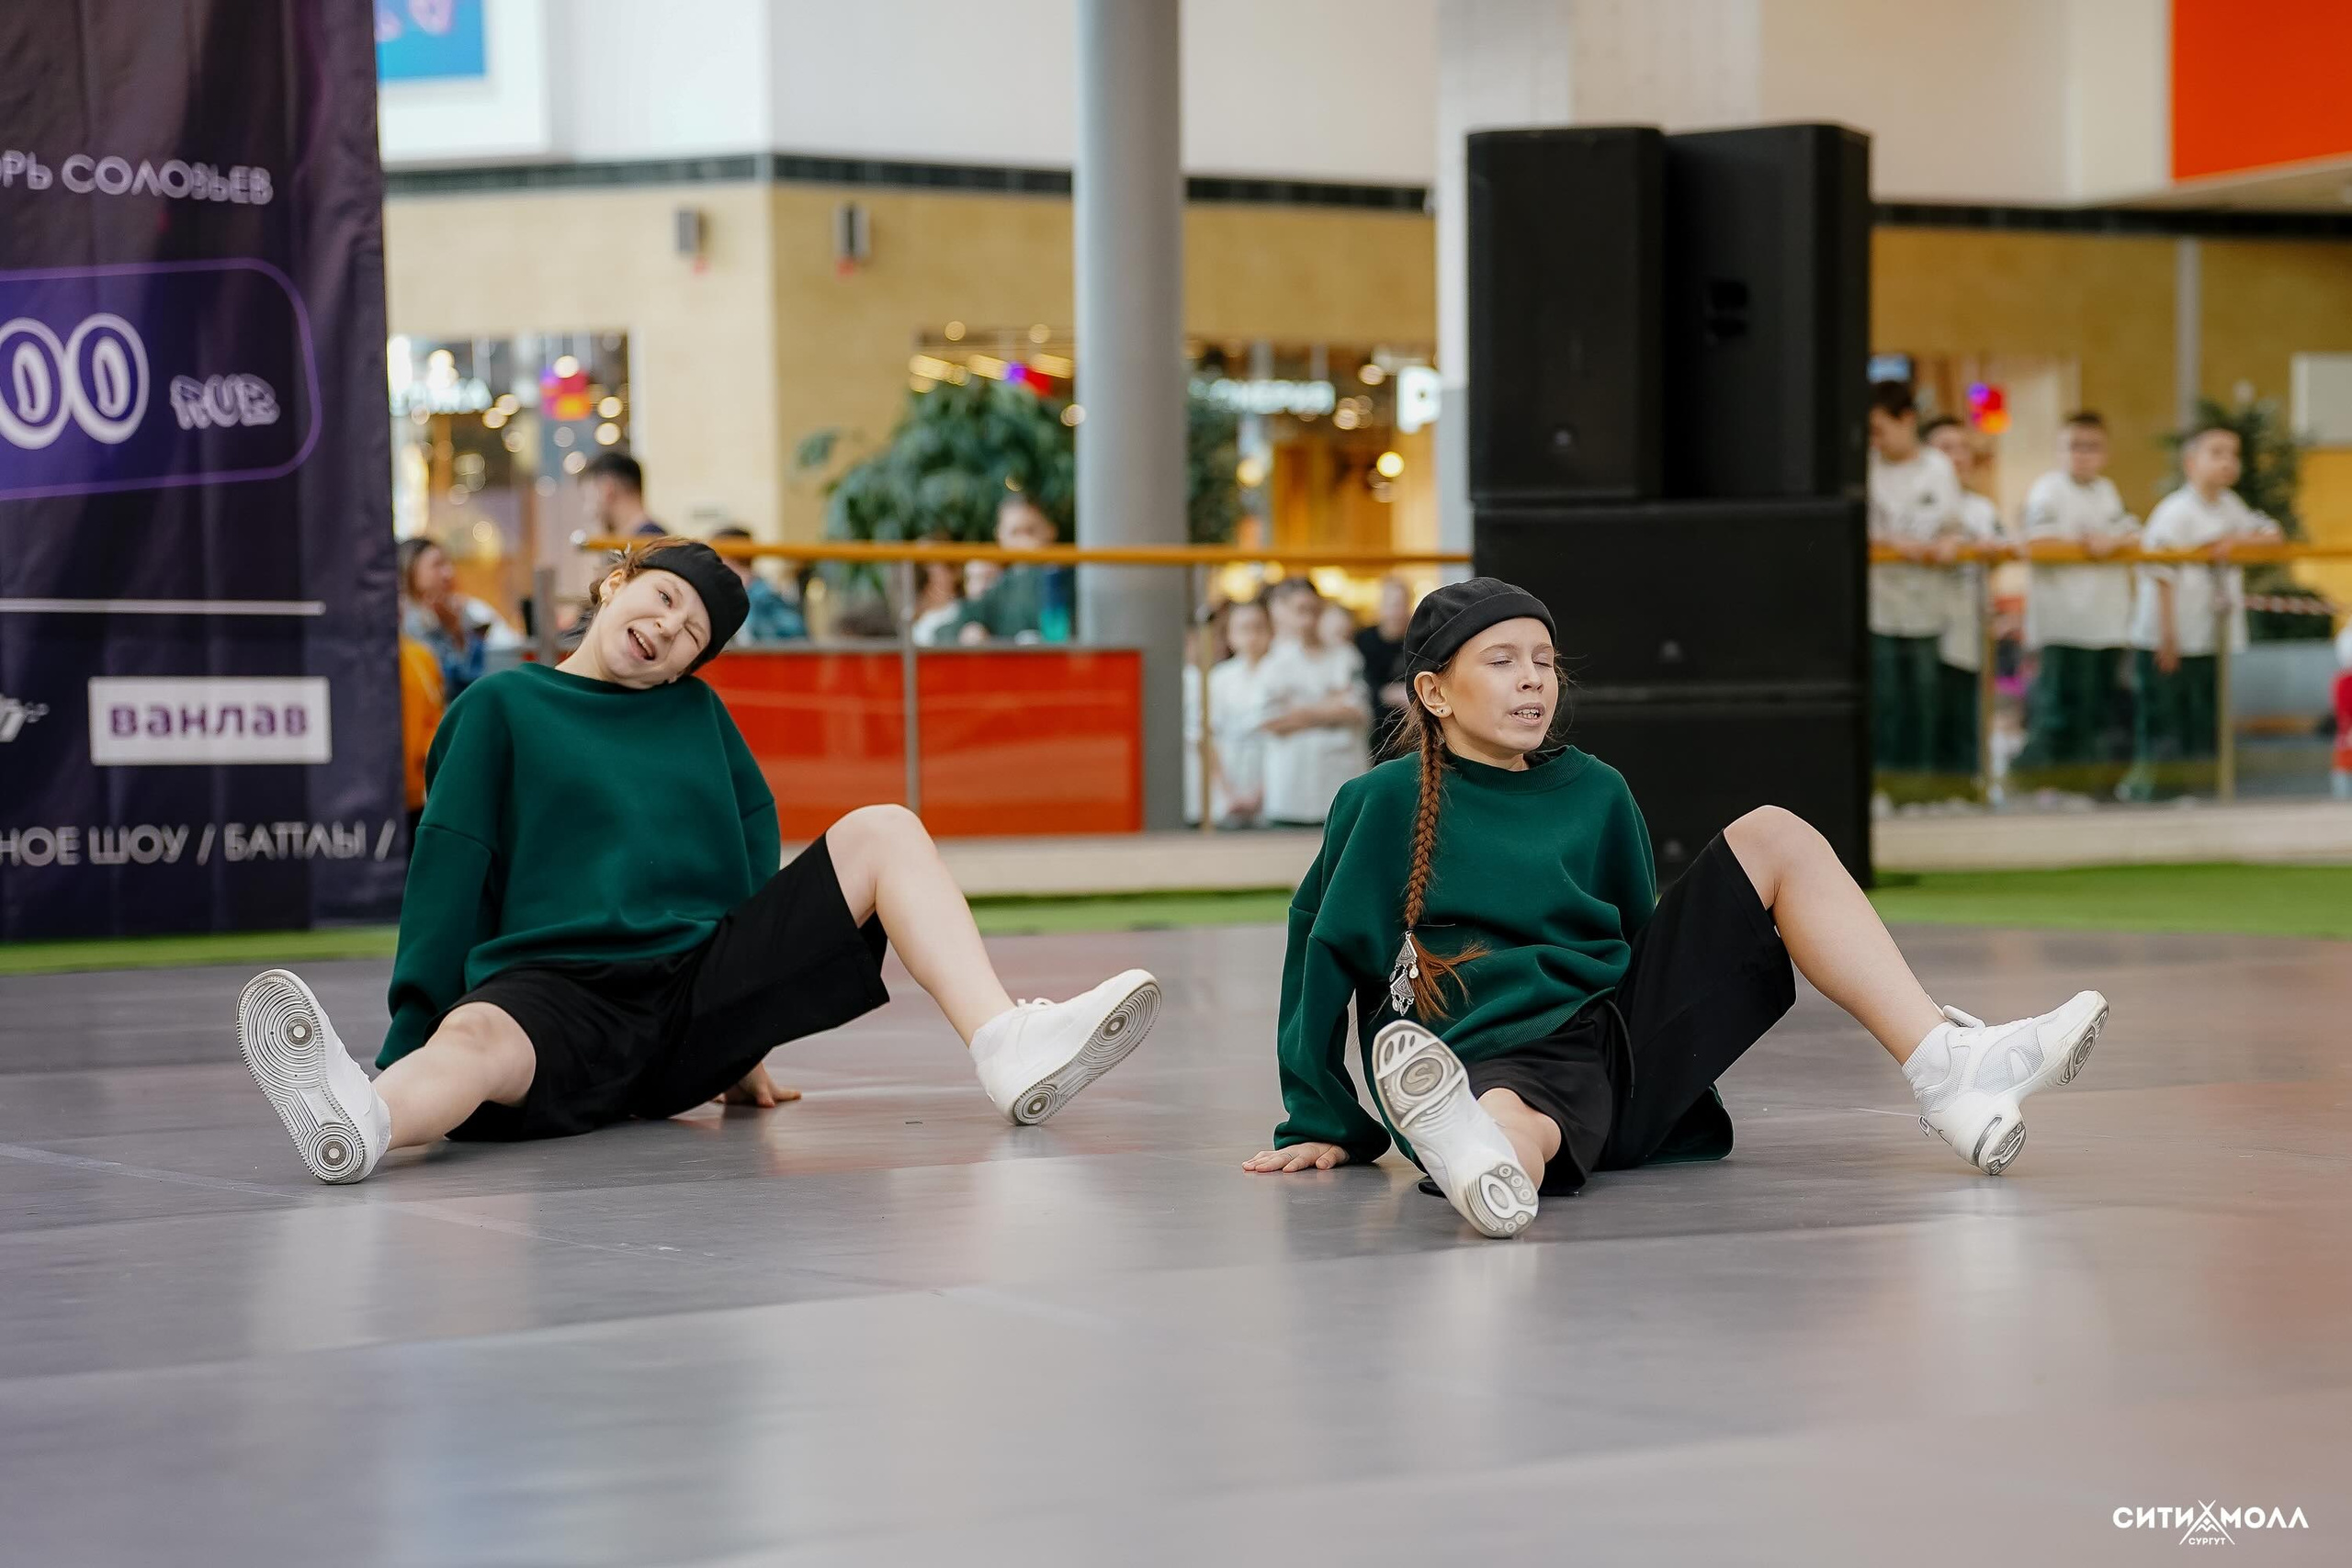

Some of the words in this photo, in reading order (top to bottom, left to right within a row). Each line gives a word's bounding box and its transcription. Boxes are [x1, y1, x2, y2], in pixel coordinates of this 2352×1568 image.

[0, 150, 53, 190] РЬ
[88, 824, 188, 864] ШОУ
[224, 821, 366, 862] БАТТЛЫ
